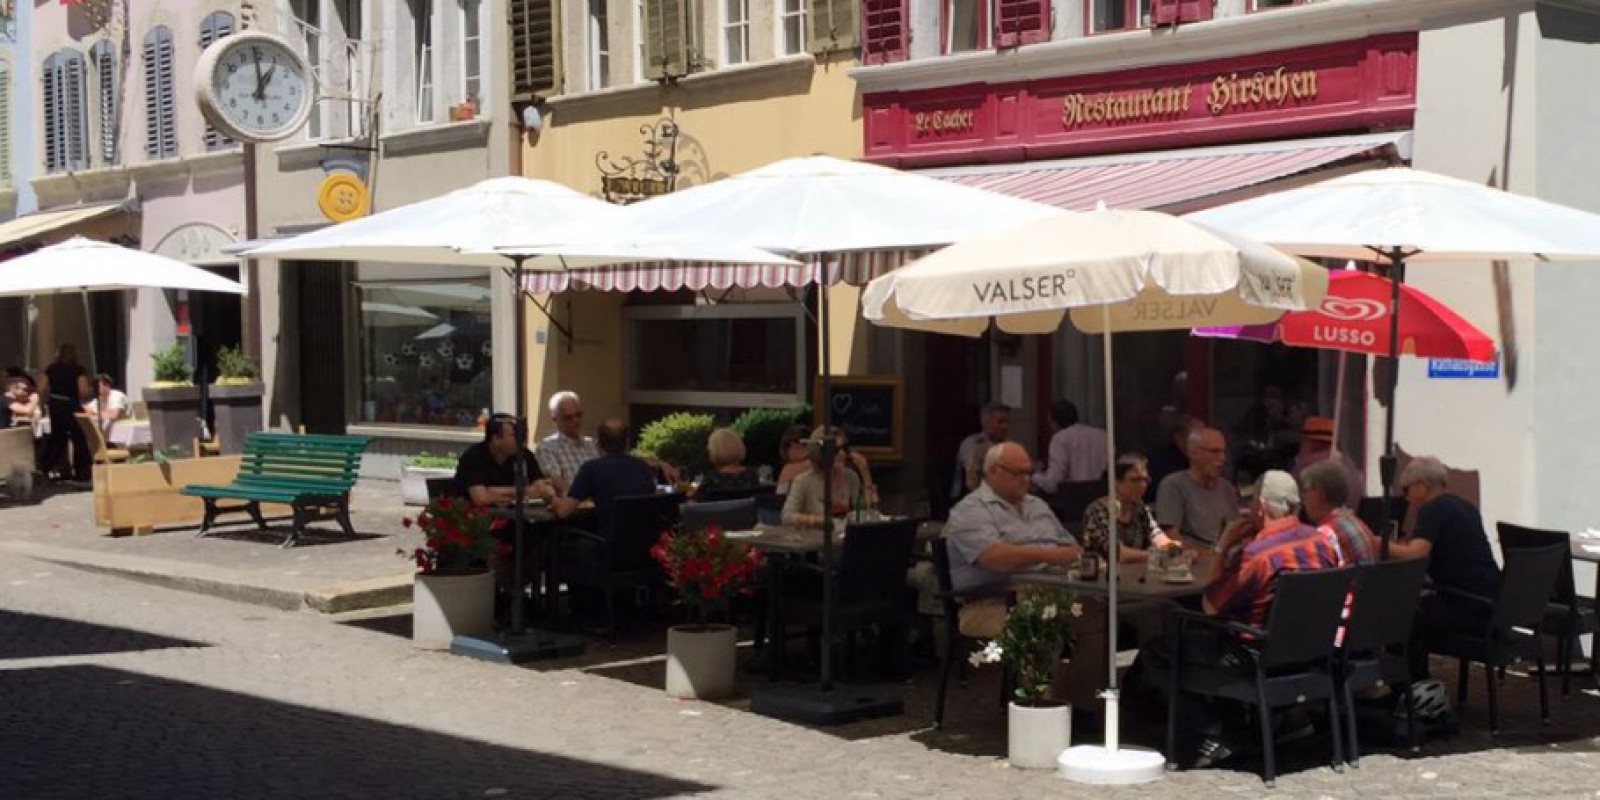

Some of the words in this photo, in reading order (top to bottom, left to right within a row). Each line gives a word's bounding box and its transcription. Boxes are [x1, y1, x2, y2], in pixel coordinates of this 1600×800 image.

[1063, 83, 1193, 126] Restaurant
[1207, 67, 1318, 115] Hirschen
[972, 273, 1067, 303] VALSER
[1313, 325, 1376, 346] LUSSO
